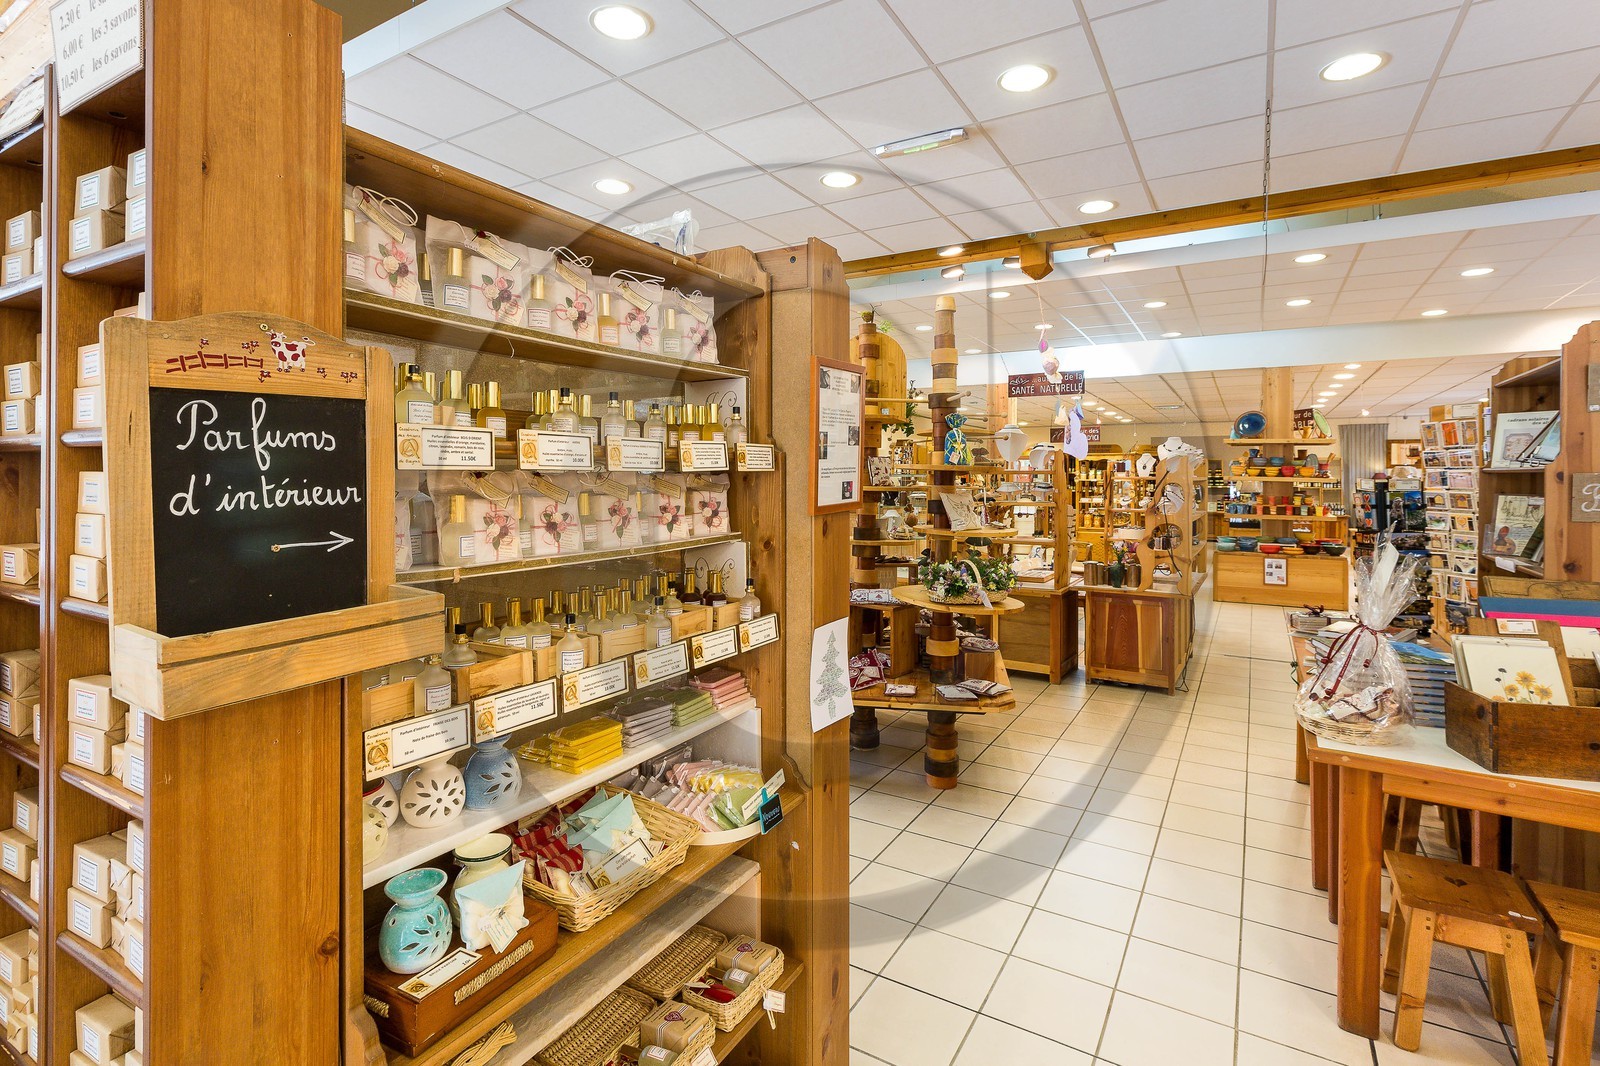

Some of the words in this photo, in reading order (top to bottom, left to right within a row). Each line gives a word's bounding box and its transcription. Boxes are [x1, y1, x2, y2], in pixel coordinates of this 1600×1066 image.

[60, 9, 74, 31] 2.30
[76, 4, 80, 19] €
[63, 38, 77, 60] 6.00
[79, 34, 83, 49] €
[92, 27, 101, 42] les
[104, 19, 108, 34] 3
[110, 4, 137, 30] savons
[62, 69, 78, 91] 10.50
[80, 64, 84, 79] €
[93, 58, 102, 72] les
[104, 49, 108, 64] 6
[111, 36, 137, 61] savons
[1012, 384, 1034, 394] SANTÉ
[1040, 383, 1082, 393] NATURELLE
[175, 397, 337, 471] Parfums
